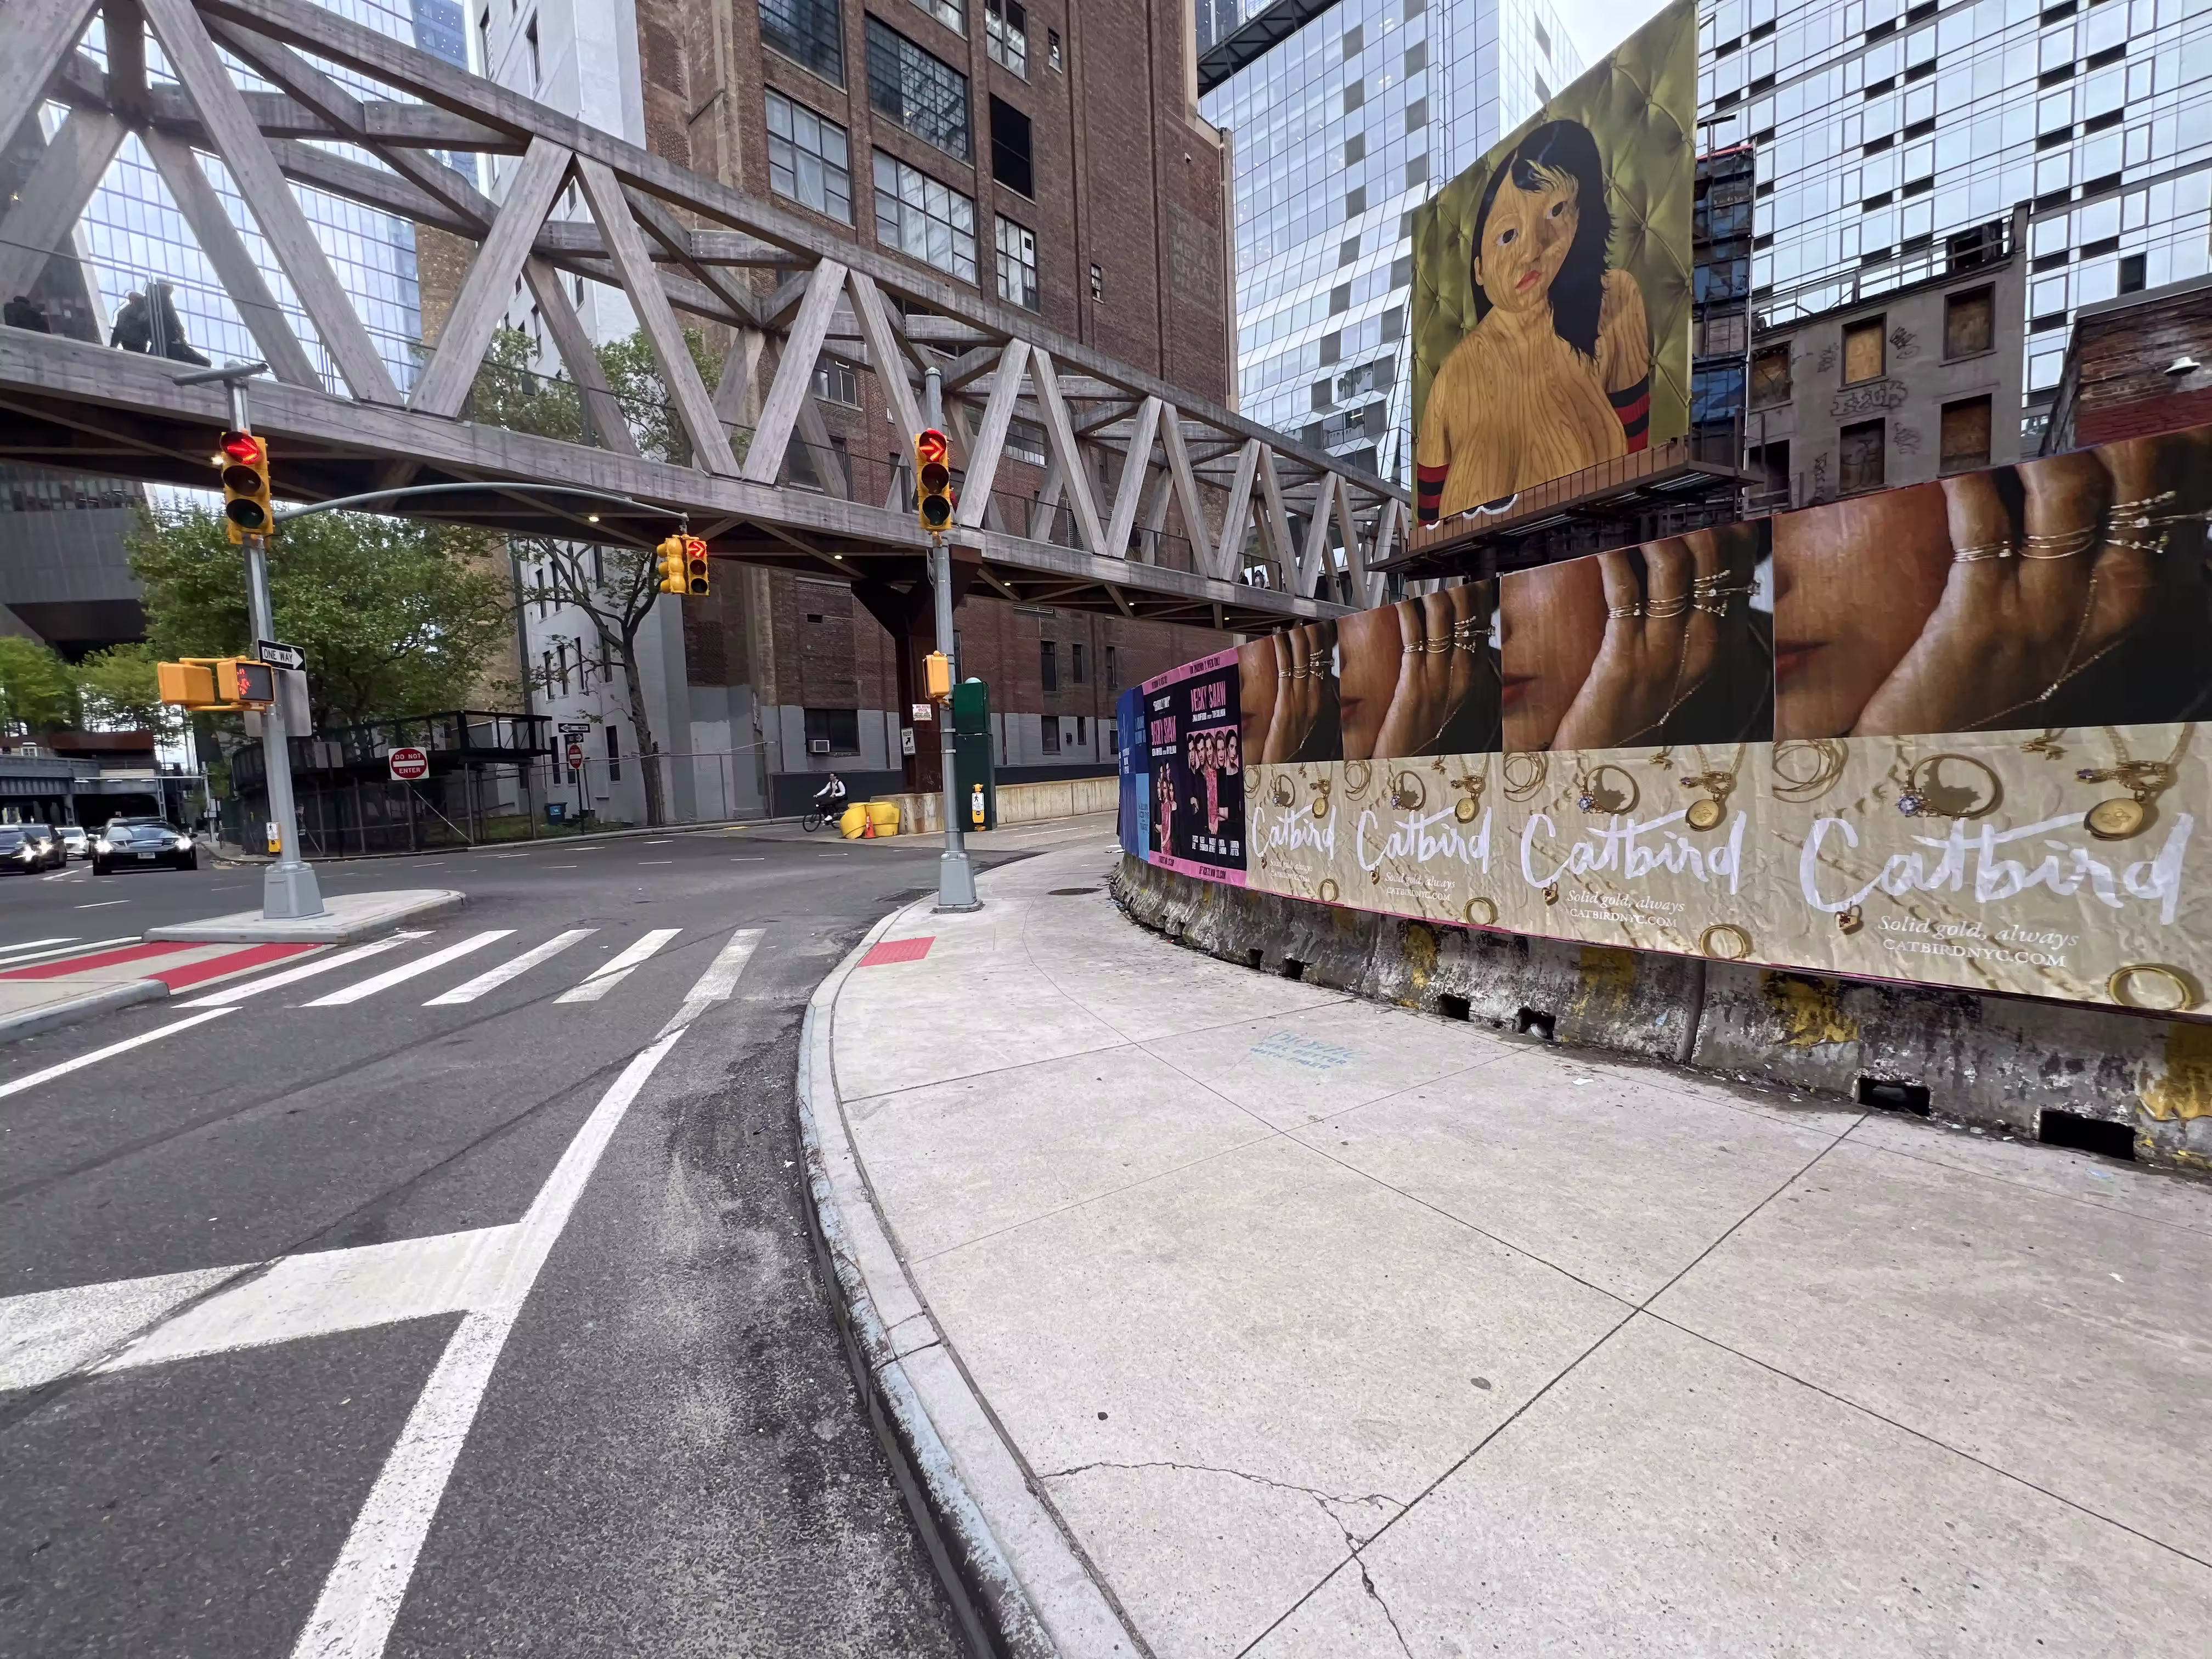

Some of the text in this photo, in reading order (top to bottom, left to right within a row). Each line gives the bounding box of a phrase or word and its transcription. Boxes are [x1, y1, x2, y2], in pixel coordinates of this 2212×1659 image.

[264, 648, 292, 663] ONE WAY
[1209, 681, 1226, 708] SHAW
[1252, 805, 1336, 860] Catbird
[1357, 806, 1491, 873] Catbird
[1520, 809, 1747, 895] Catbird
[1385, 872, 1455, 891] Solid gold, always
[1799, 811, 2193, 925] Catbird
[1387, 887, 1451, 901] CATBIRDNYC.COM
[1567, 890, 1685, 915] Solid gold, always
[1570, 909, 1677, 927] CATBIRDNYC.COM
[1878, 915, 2079, 950] Solid gold, always
[1883, 938, 2067, 967] CATBIRDNYC.COM
